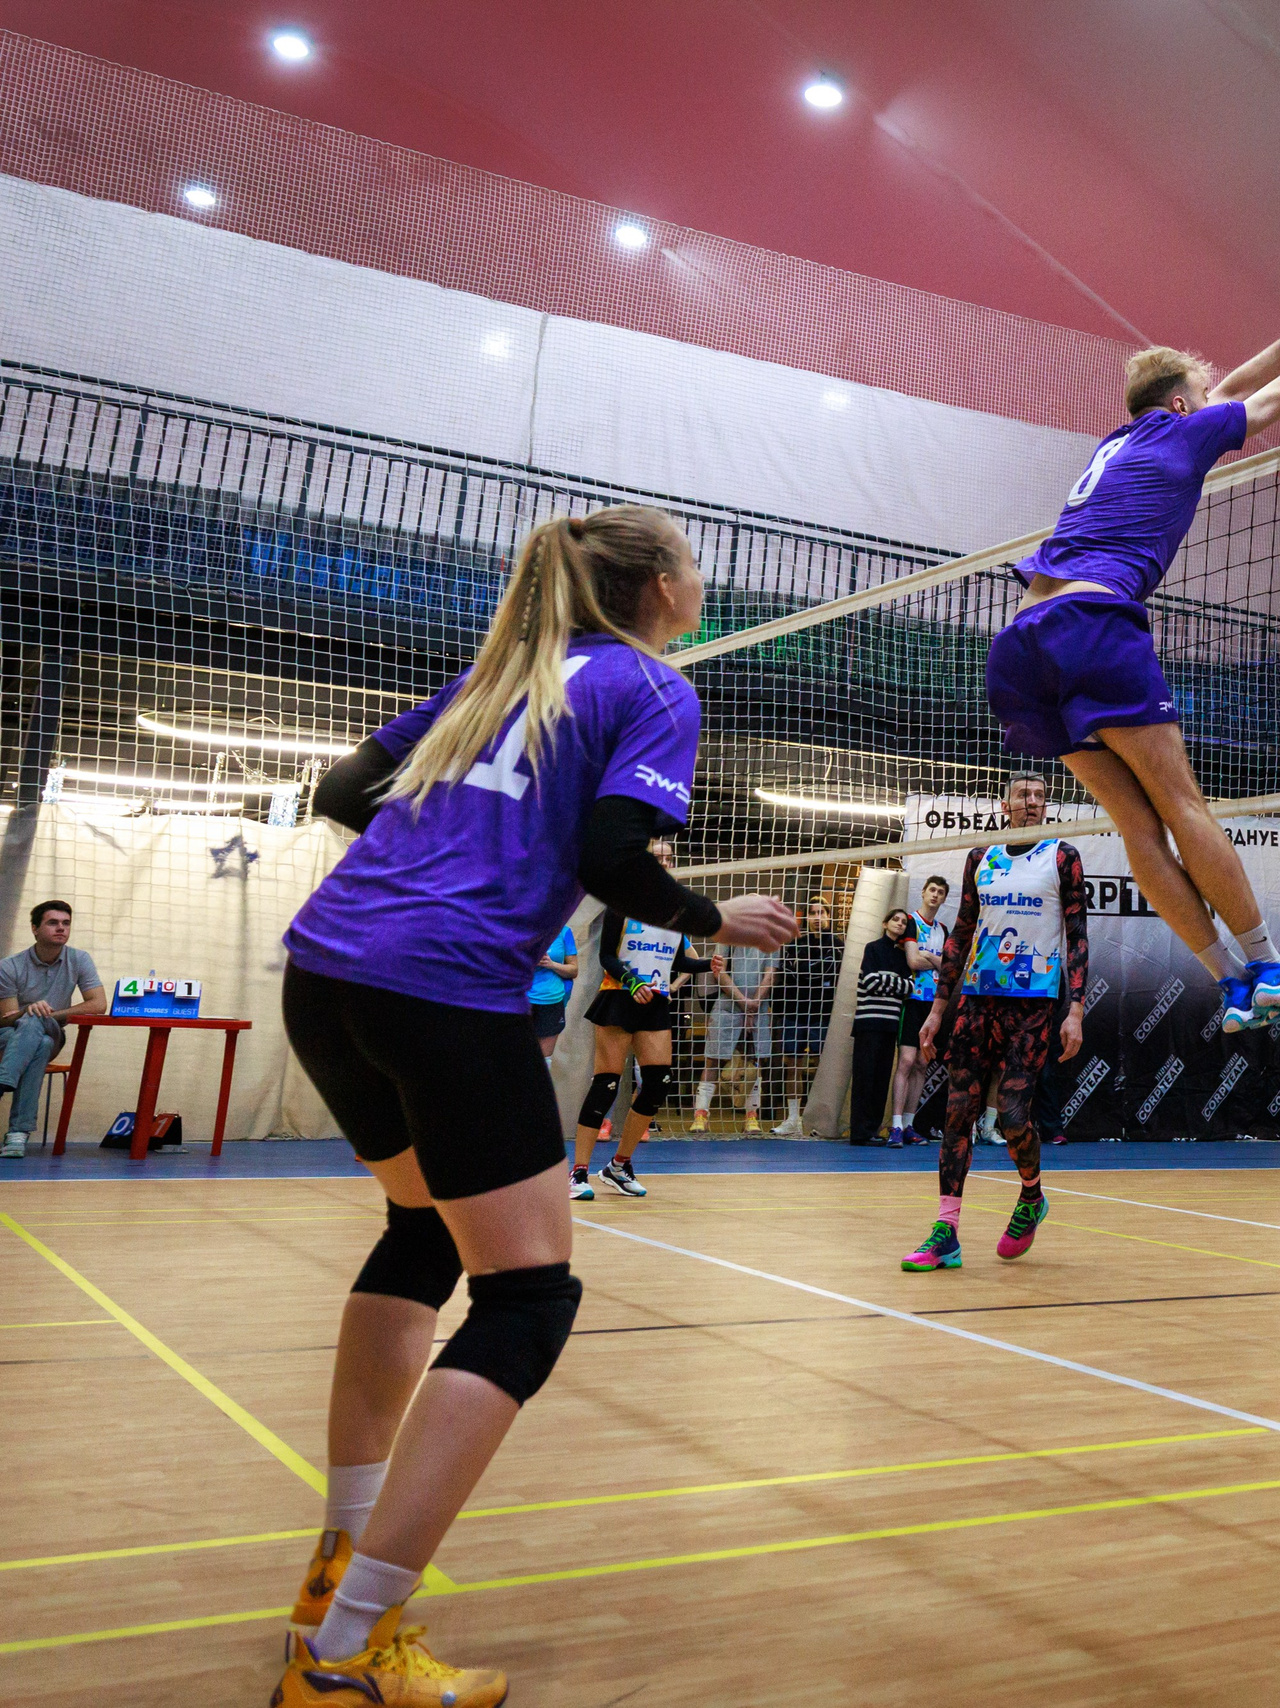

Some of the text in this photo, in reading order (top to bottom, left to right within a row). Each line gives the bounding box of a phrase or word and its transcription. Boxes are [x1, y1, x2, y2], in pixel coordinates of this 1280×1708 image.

[1067, 433, 1130, 507] 8
[979, 892, 1044, 908] StarLine
[627, 940, 675, 955] StarLin
[123, 980, 139, 995] 4
[184, 982, 194, 996] 1
[114, 1006, 140, 1015] HOME
[172, 1008, 198, 1016] GUEST
